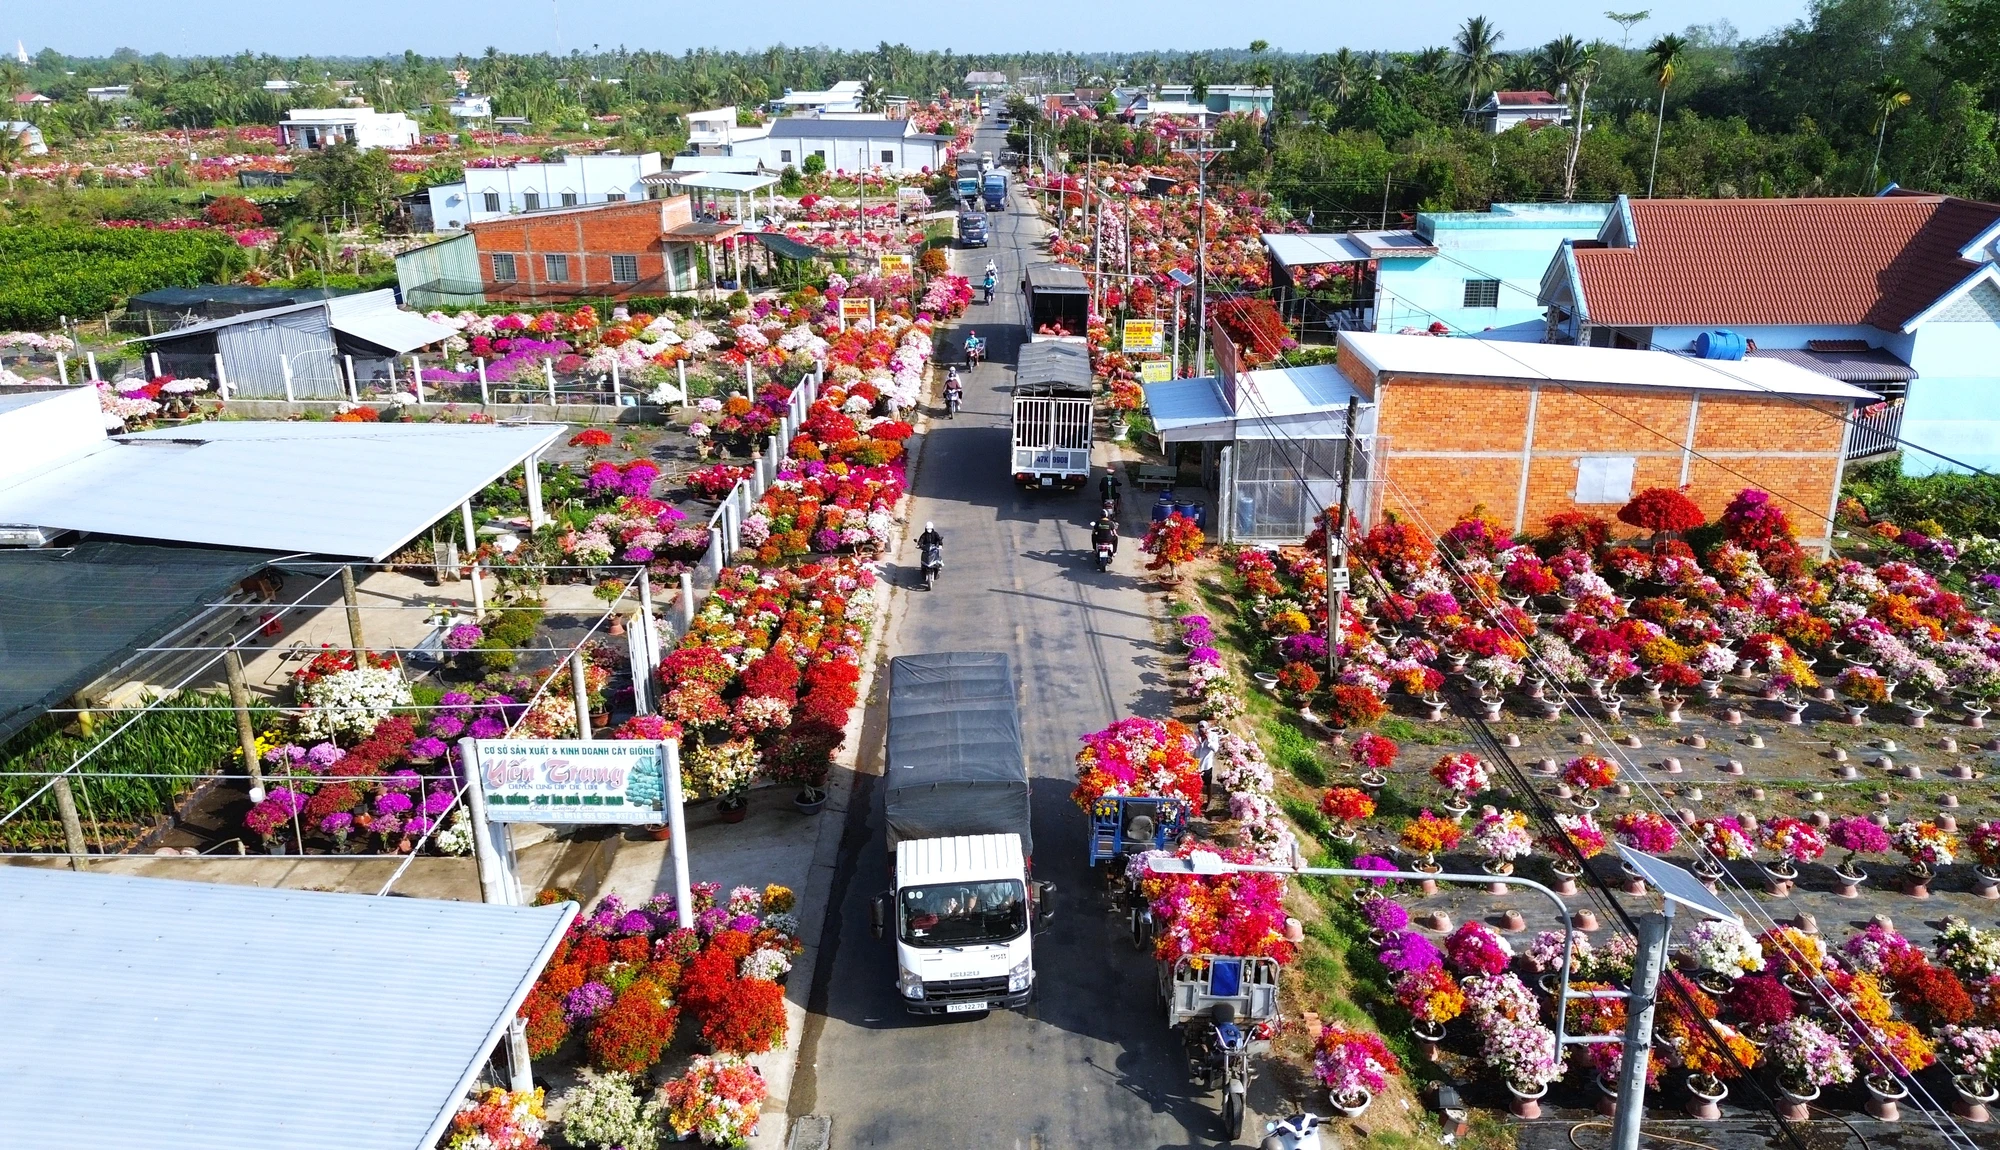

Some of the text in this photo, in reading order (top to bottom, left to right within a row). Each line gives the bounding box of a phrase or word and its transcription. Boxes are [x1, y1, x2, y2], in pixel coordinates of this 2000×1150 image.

[484, 744, 655, 755] CƠ SỞ SẢN XUẤT & KINH DOANH CÂY GIỐNG
[482, 757, 625, 789] Yến Trang
[950, 970, 980, 978] ISUZU
